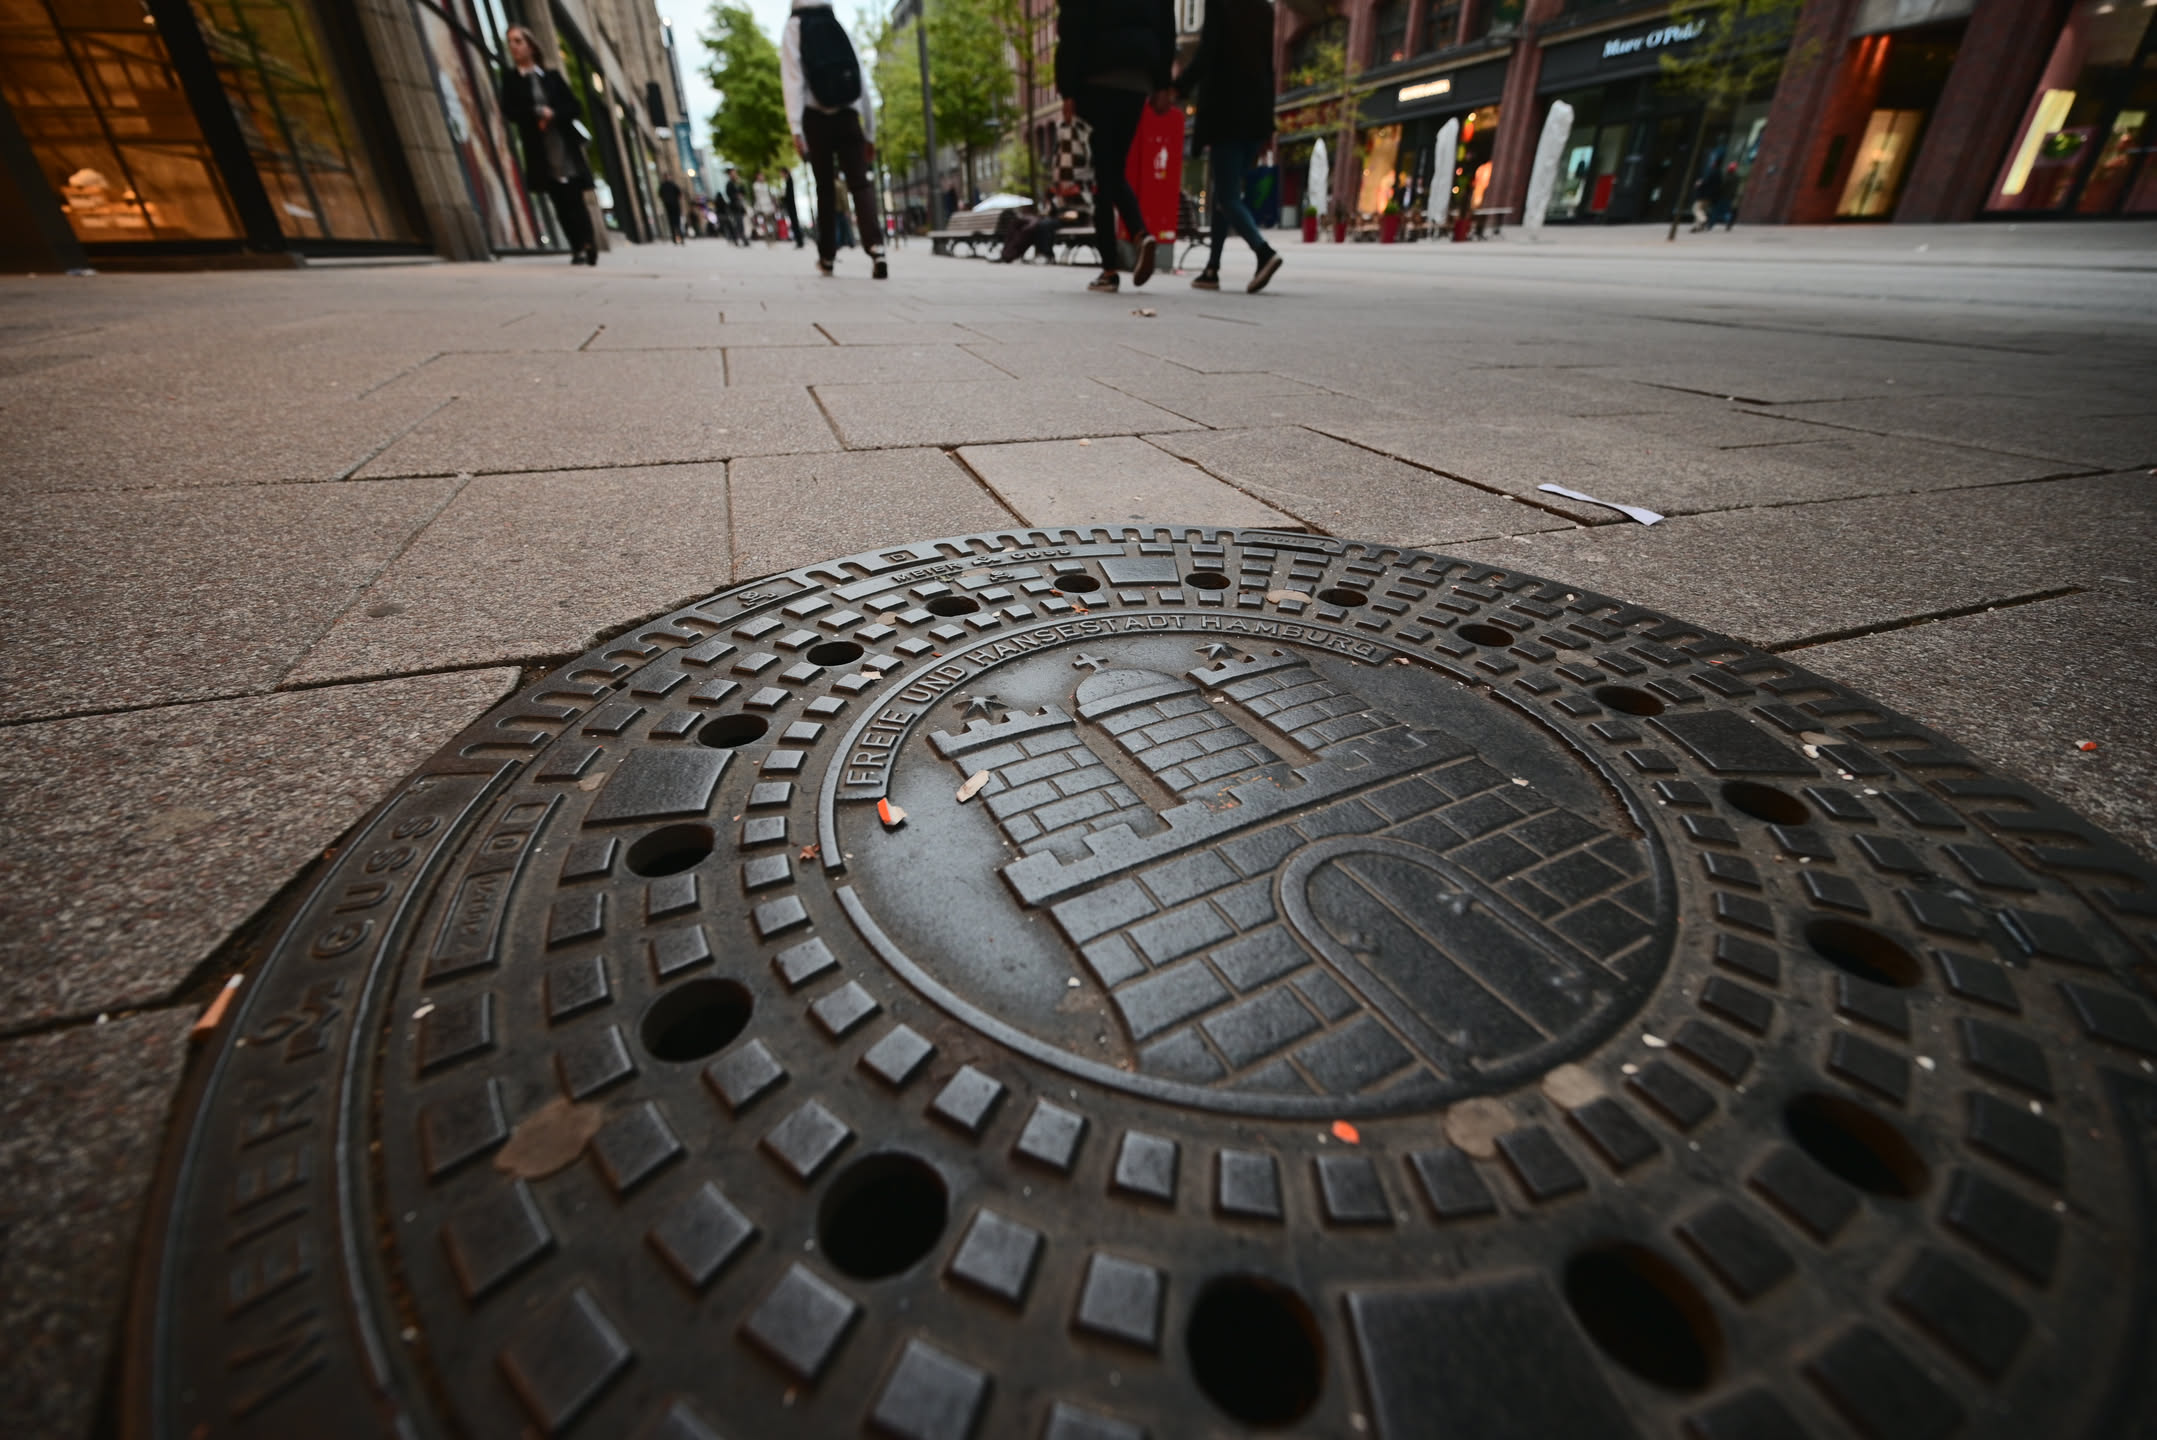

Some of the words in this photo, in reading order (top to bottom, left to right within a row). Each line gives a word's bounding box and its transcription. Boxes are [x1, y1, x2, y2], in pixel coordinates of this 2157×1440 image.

[1602, 38, 1645, 59] Marc
[892, 561, 962, 583] MEIER
[1011, 547, 1071, 560] GUSS
[845, 708, 917, 787] FREIE
[900, 663, 967, 703] UND
[963, 614, 1186, 668] HANSESTADT
[1200, 615, 1378, 657] HAMBURG
[308, 815, 442, 961] GUSS
